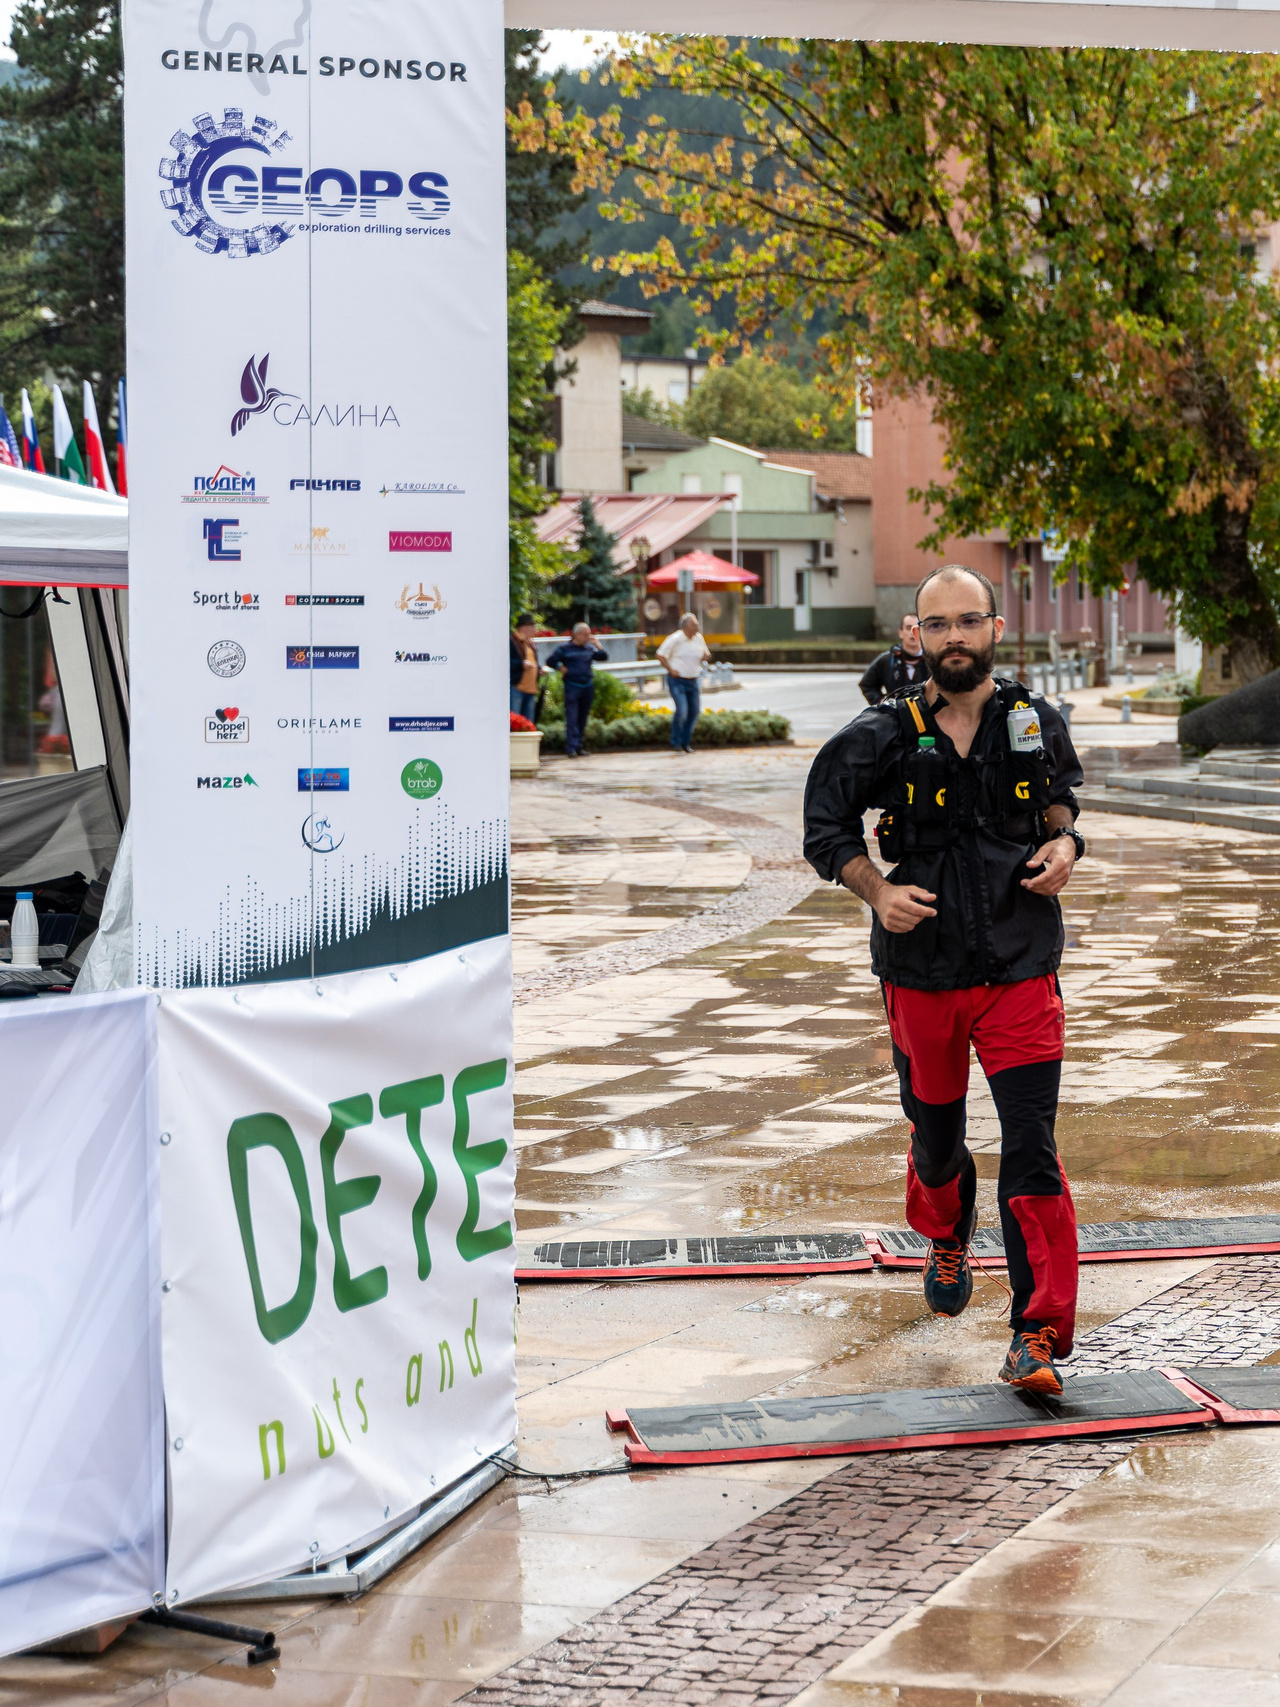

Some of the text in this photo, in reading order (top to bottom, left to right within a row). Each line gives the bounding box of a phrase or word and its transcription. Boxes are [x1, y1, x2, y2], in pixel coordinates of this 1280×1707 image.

[161, 50, 468, 82] GENERAL SPONSOR
[207, 164, 451, 221] GEOPS
[299, 223, 451, 236] exploration drilling services
[273, 403, 401, 427] САЛИНА
[194, 476, 255, 491] ПОДЕМ
[294, 543, 346, 551] MARYAN
[193, 590, 229, 606] Sport
[208, 721, 246, 733] Doppel
[277, 718, 362, 728] ORIFLAME
[216, 730, 239, 740] herz
[259, 1298, 484, 1481] nuts and
